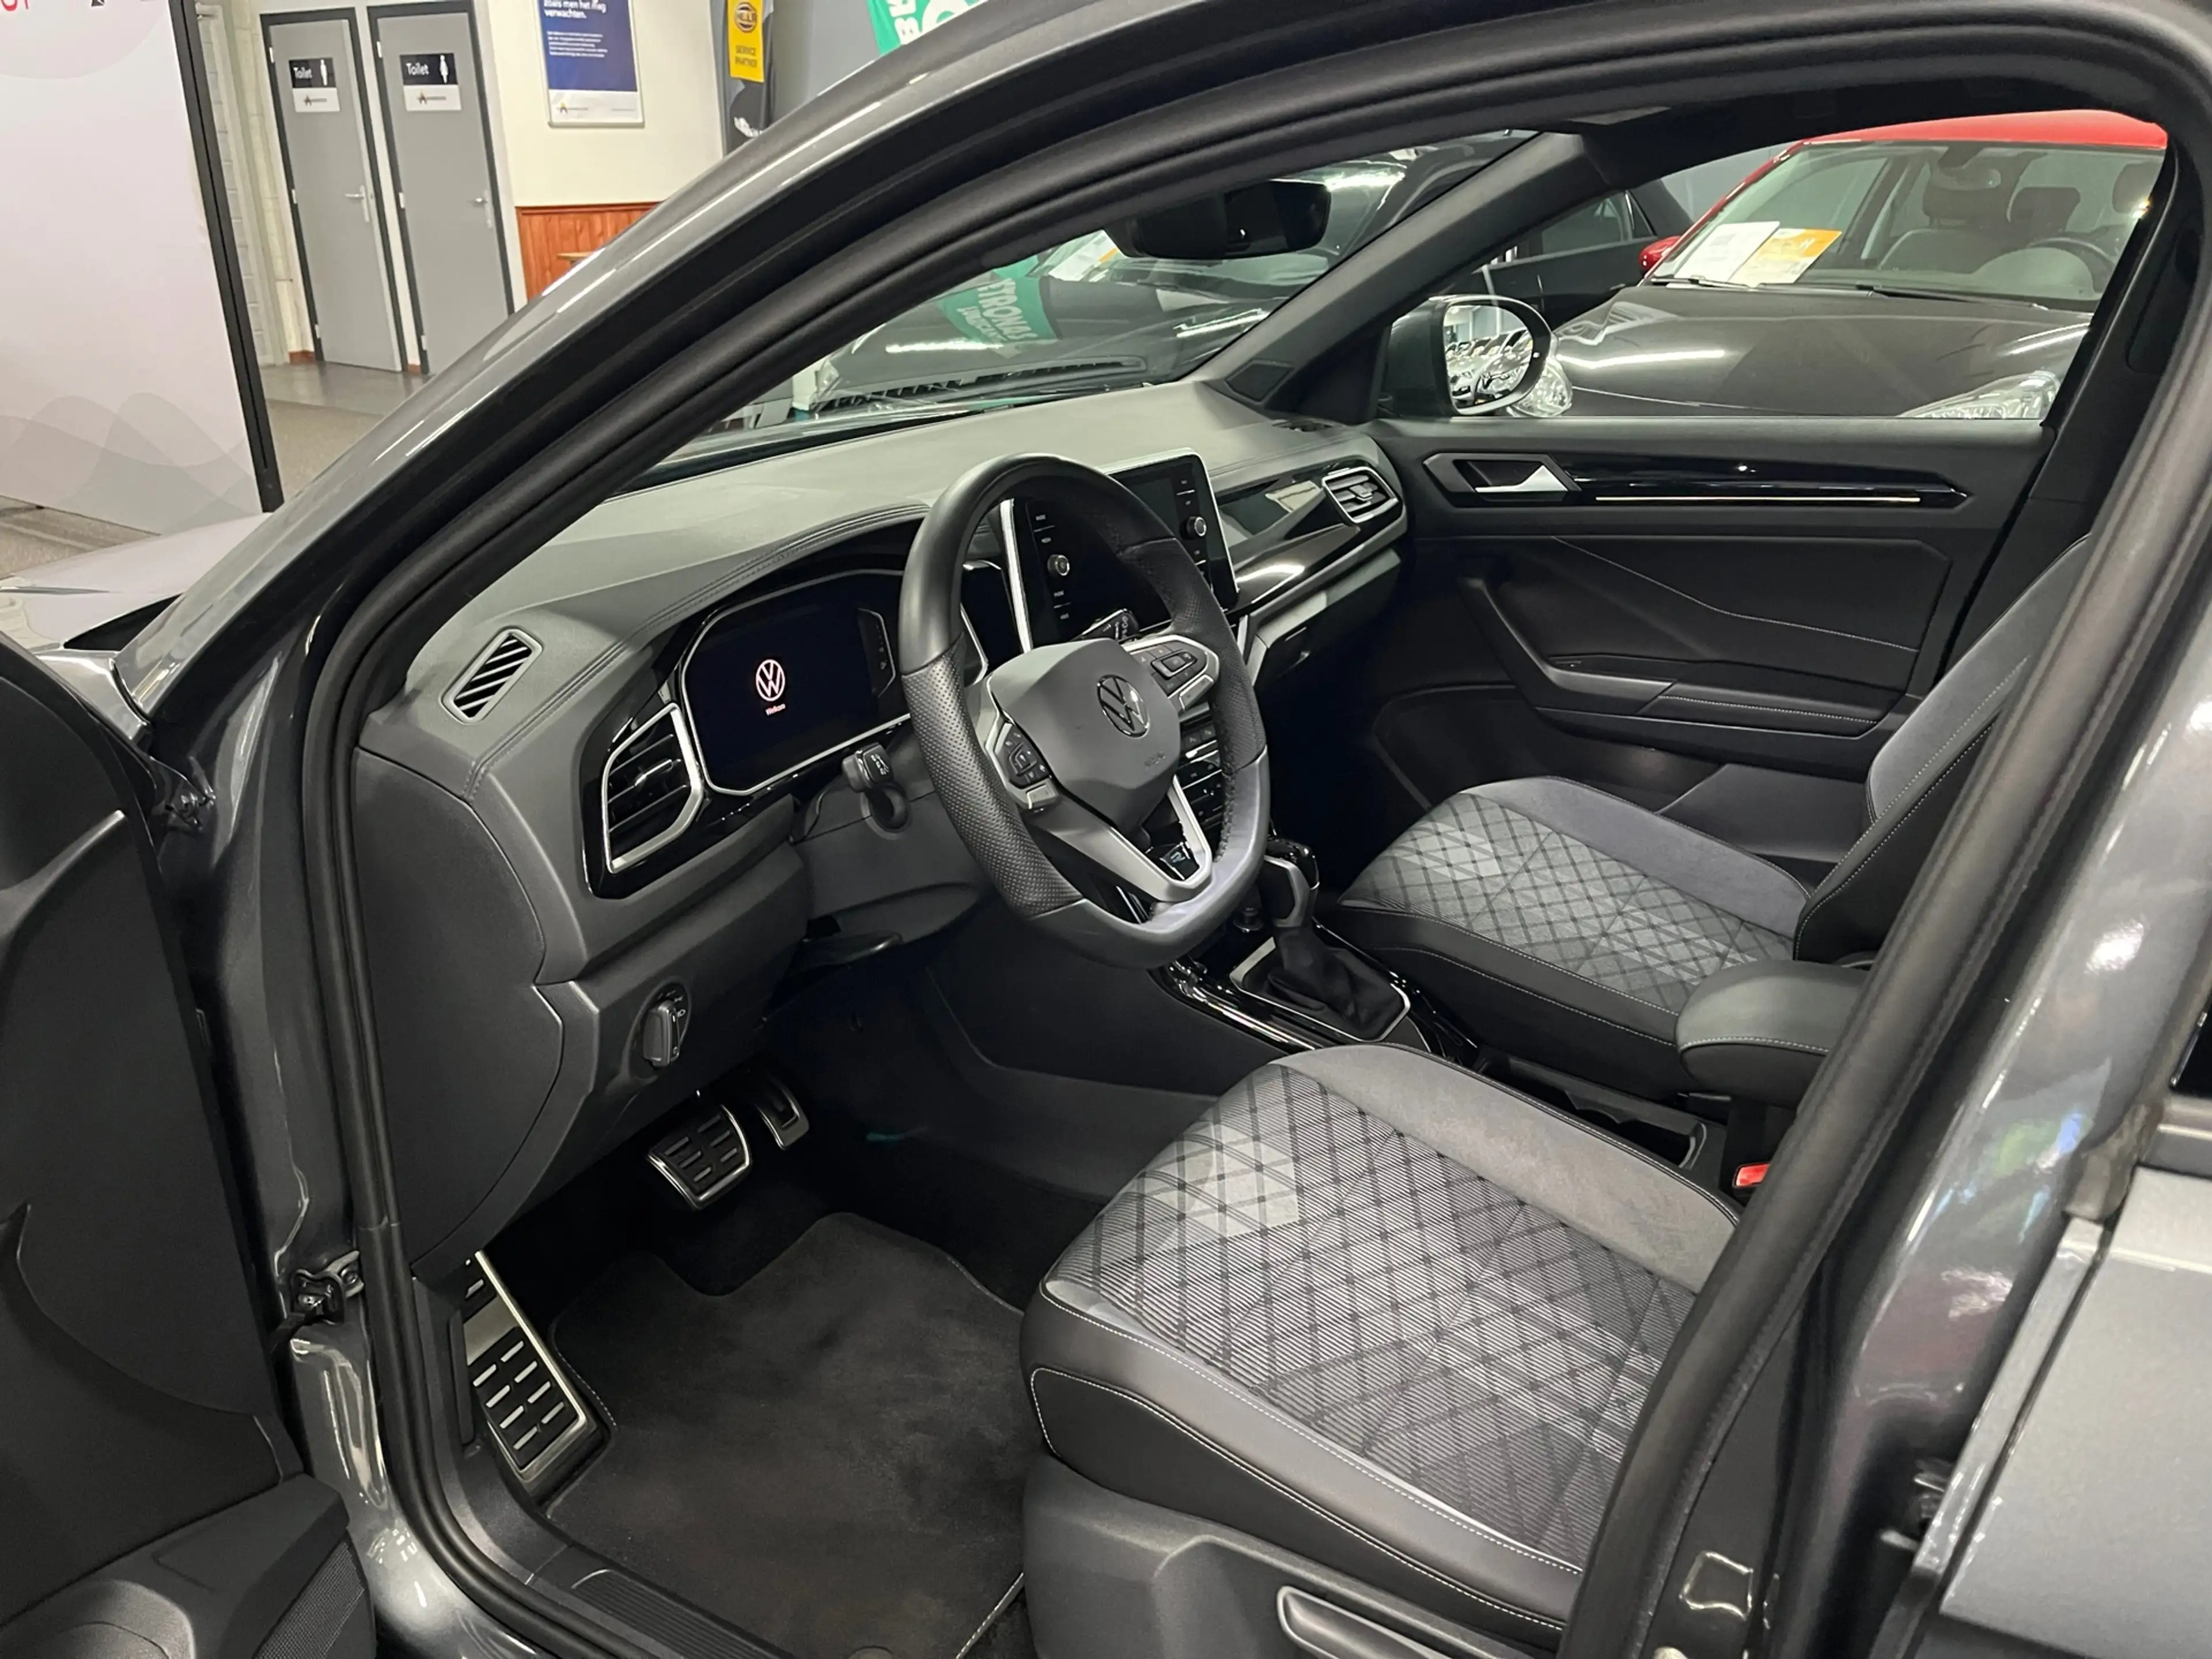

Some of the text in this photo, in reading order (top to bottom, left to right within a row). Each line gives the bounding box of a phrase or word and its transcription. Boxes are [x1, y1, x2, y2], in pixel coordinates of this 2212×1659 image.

[293, 66, 313, 79] Toilet
[406, 62, 430, 76] Toilet
[977, 278, 1038, 340] ETRONAS
